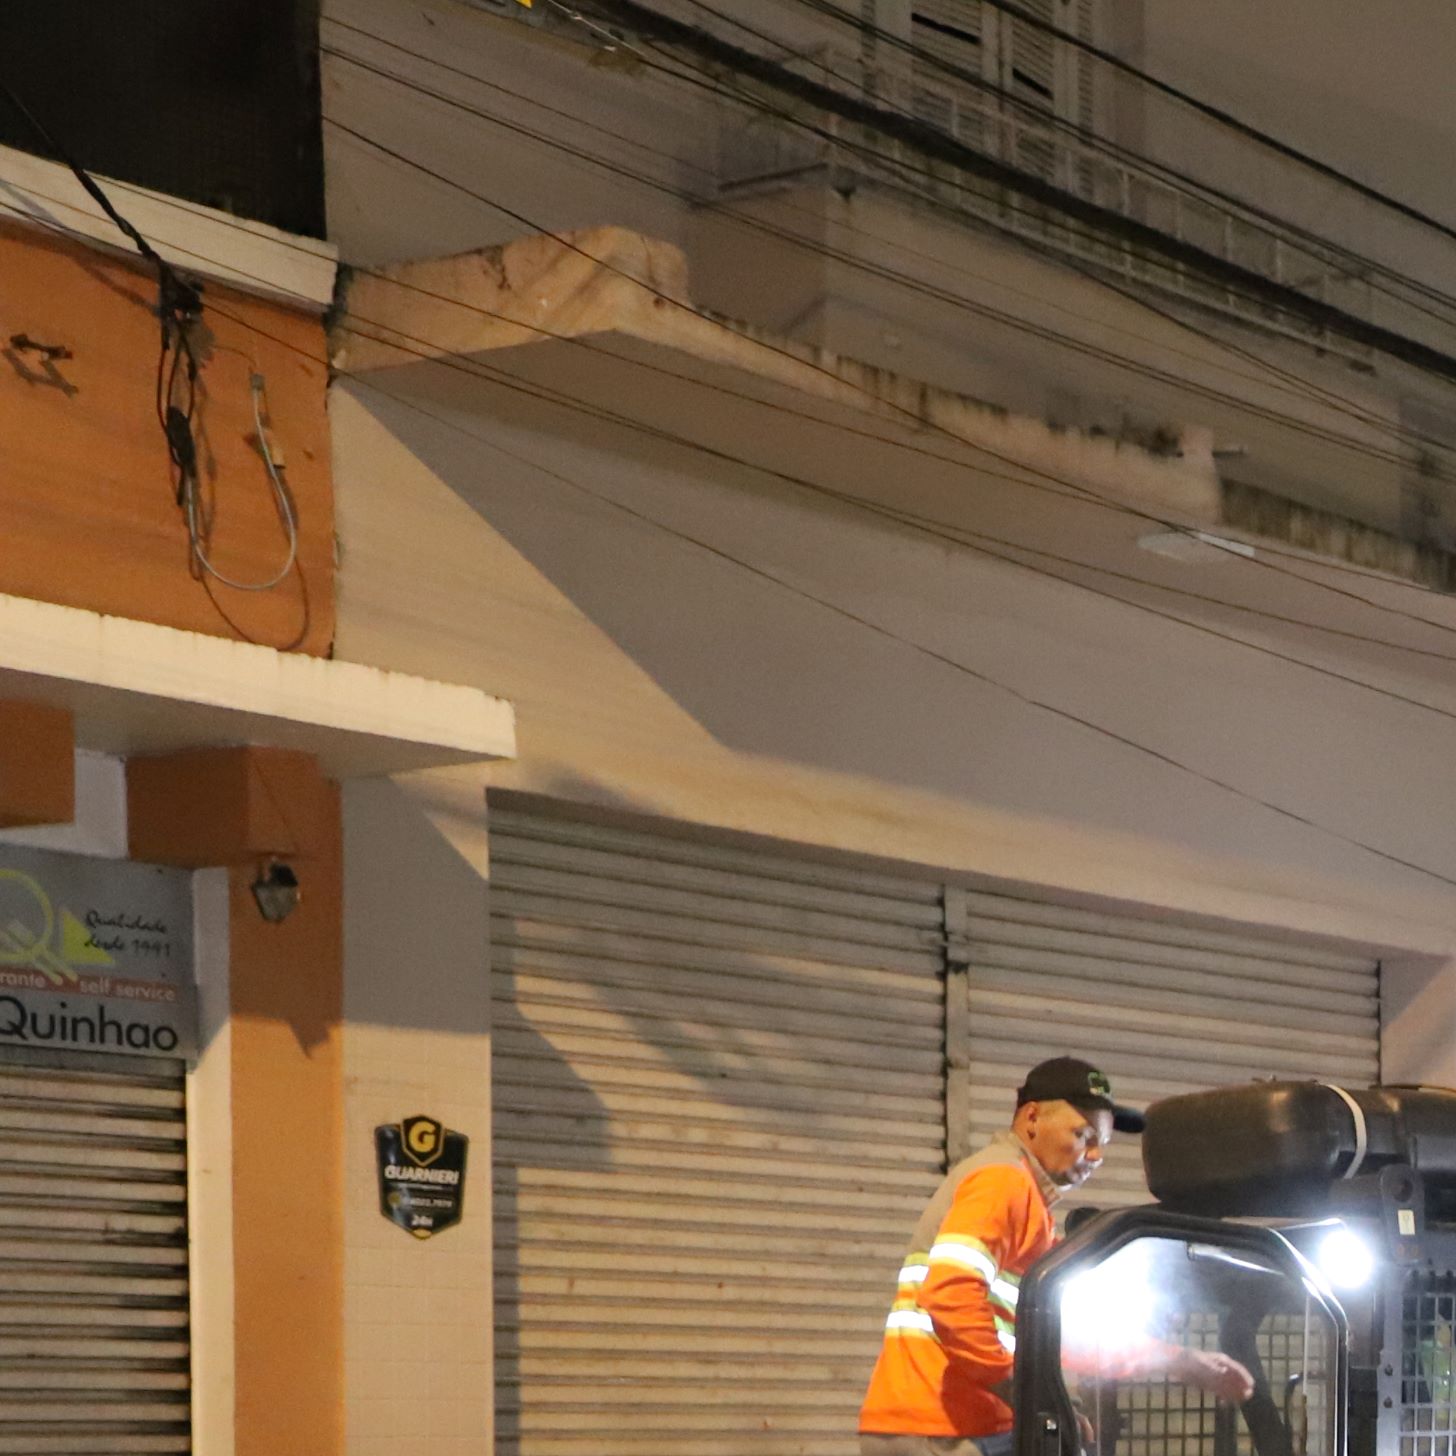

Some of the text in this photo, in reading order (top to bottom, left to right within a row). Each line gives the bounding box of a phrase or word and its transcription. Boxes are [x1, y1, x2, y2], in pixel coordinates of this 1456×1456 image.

[85, 909, 168, 934] Qualidade
[131, 938, 171, 957] 1991
[79, 976, 112, 995] self
[115, 981, 177, 1001] service
[0, 995, 179, 1051] Quinhao
[408, 1120, 437, 1153] G
[384, 1165, 460, 1185] GUARNIERI
